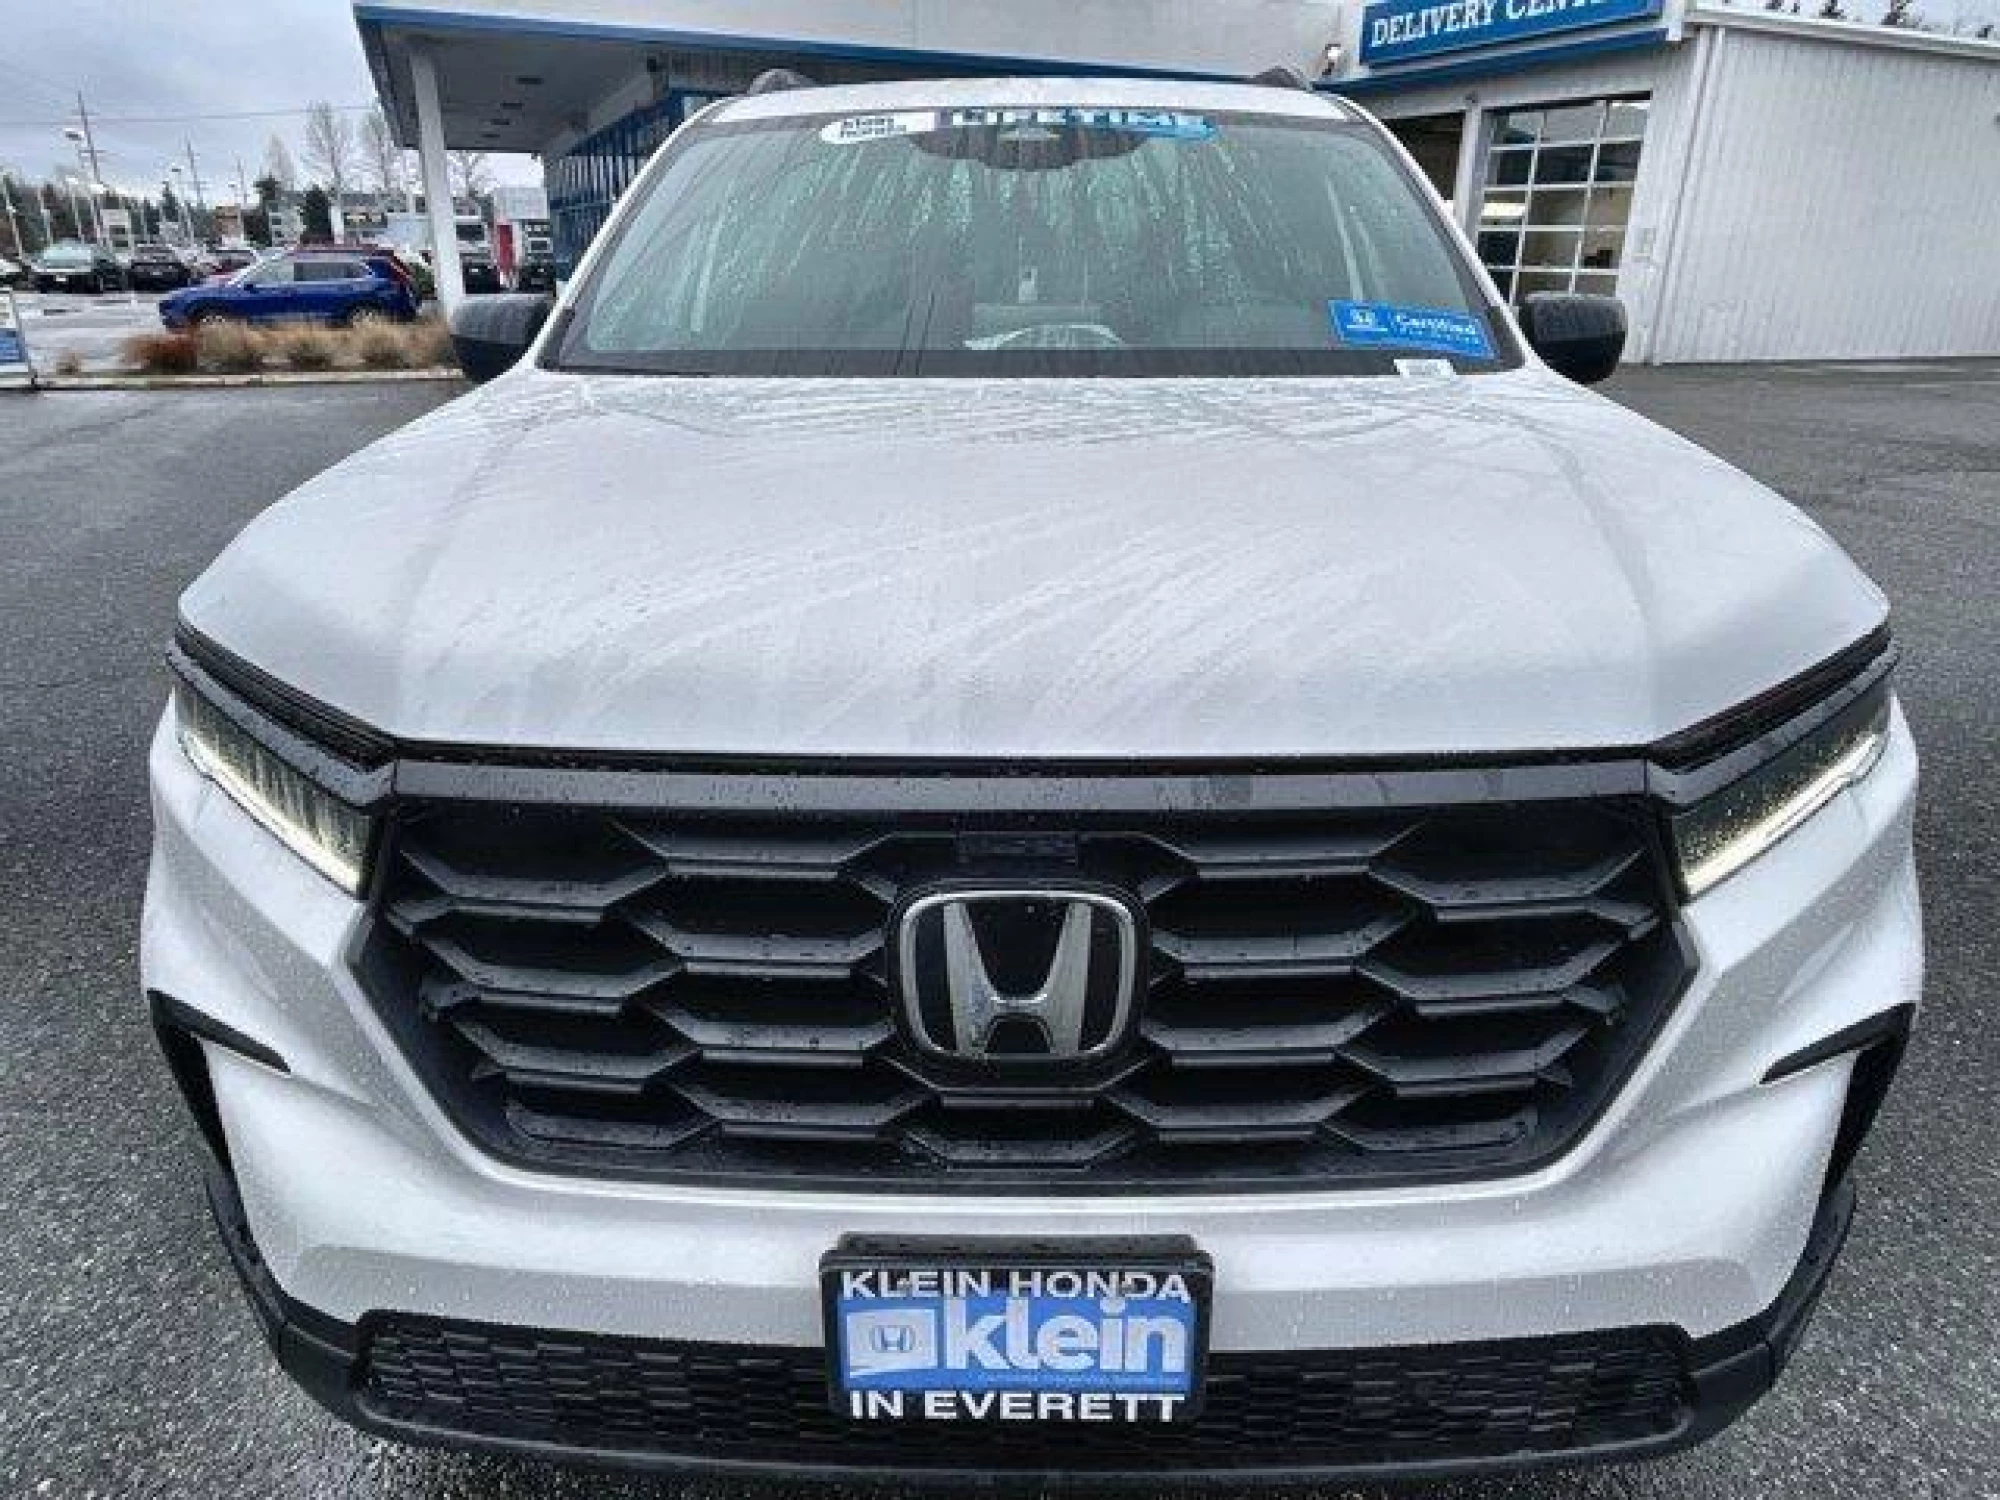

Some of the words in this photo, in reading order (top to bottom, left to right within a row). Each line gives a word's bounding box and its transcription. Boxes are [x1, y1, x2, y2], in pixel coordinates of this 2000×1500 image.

[1371, 0, 1494, 47] DELIVERY
[842, 1271, 991, 1298] KLEIN
[1009, 1271, 1192, 1303] HONDA
[944, 1297, 1188, 1373] klein
[850, 1390, 904, 1420] IN
[923, 1390, 1186, 1423] EVERETT
